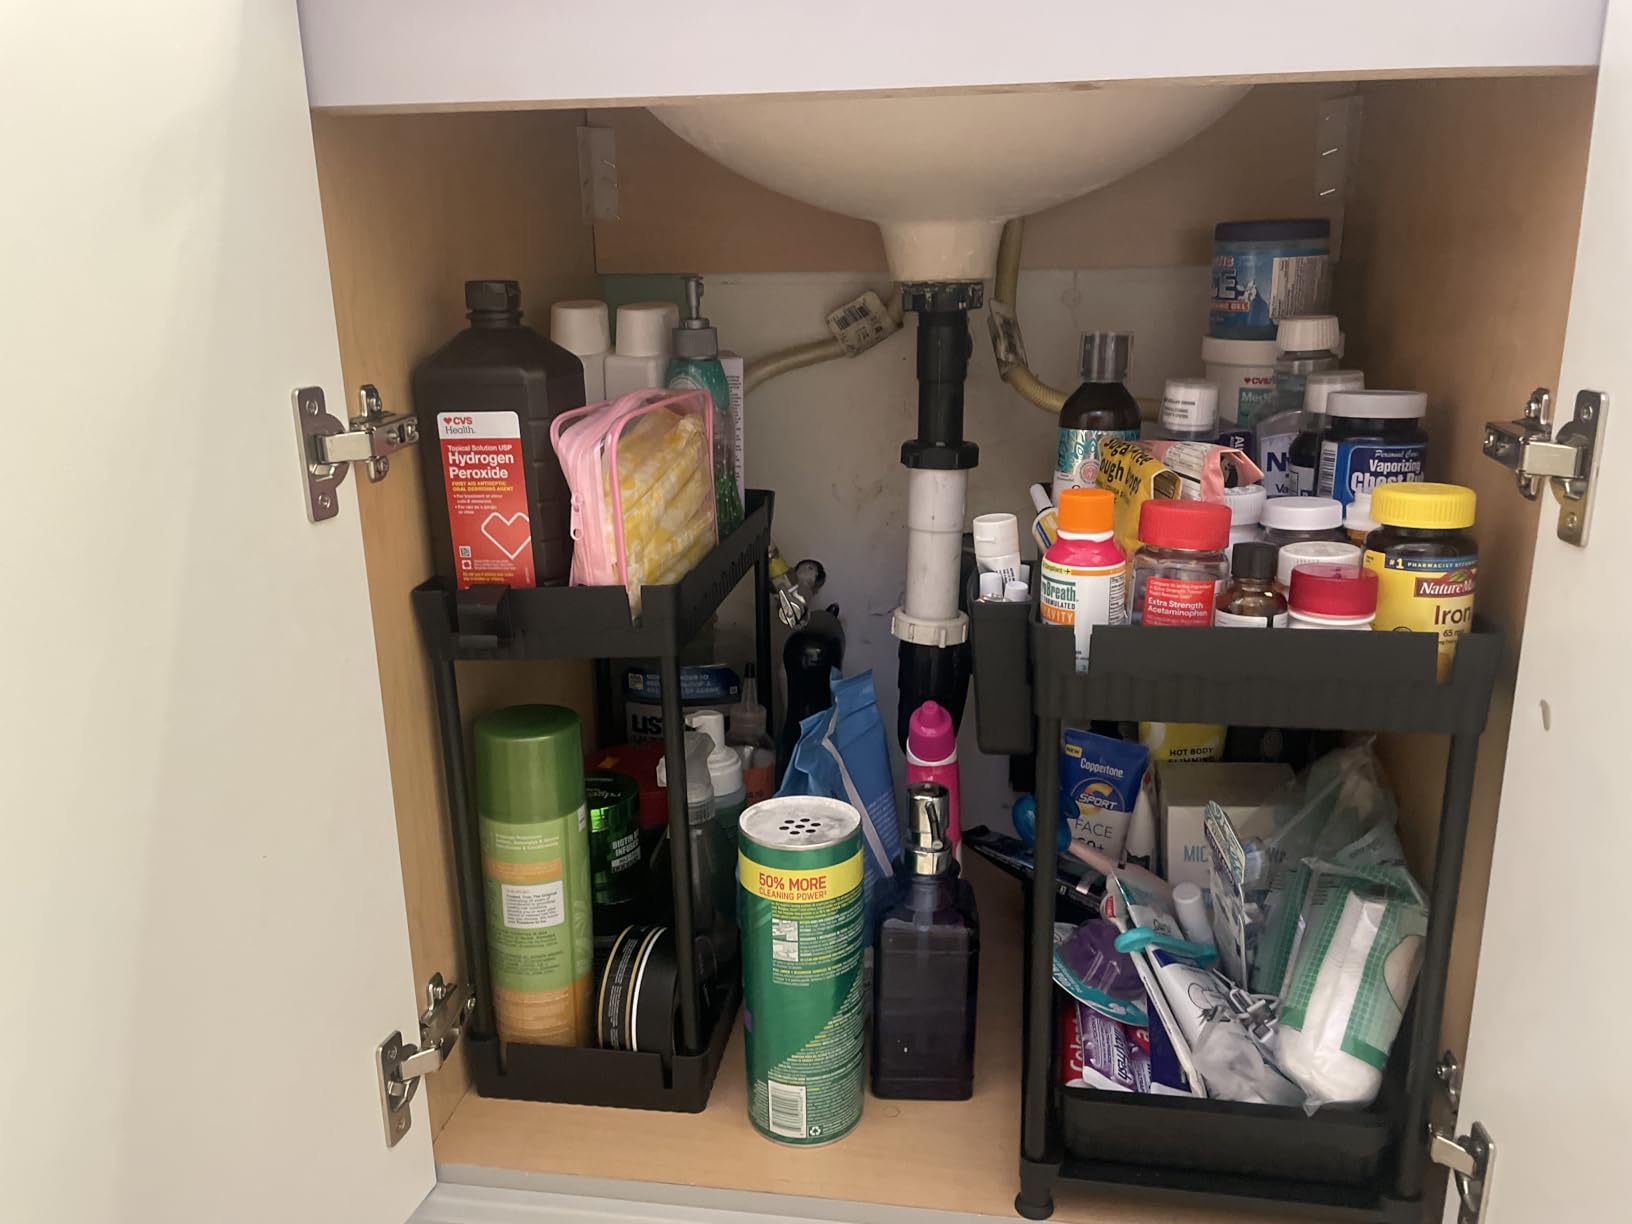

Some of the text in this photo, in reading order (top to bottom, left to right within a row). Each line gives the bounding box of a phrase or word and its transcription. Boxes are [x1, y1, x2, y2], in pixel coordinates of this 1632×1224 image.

[453, 416, 473, 425] CVS
[445, 426, 474, 434] Health
[448, 452, 514, 466] Hydrogen
[449, 466, 508, 478] Peroxide
[1100, 458, 1123, 483] ough
[1369, 458, 1421, 474] Vaporizing
[1389, 558, 1405, 569] #1
[1148, 598, 1204, 609] Extra Strength
[1147, 606, 1208, 617] Acetaminophen
[1434, 605, 1471, 625] Iron
[1443, 629, 1453, 637] 65
[632, 714, 663, 735] LIS
[1170, 747, 1213, 757] HOT BODY
[1081, 758, 1123, 777] Coppertone
[1079, 793, 1118, 809] SPORT
[1075, 819, 1113, 838] FACE
[759, 872, 826, 891] 50% MORE
[759, 887, 794, 900] CLEANING
